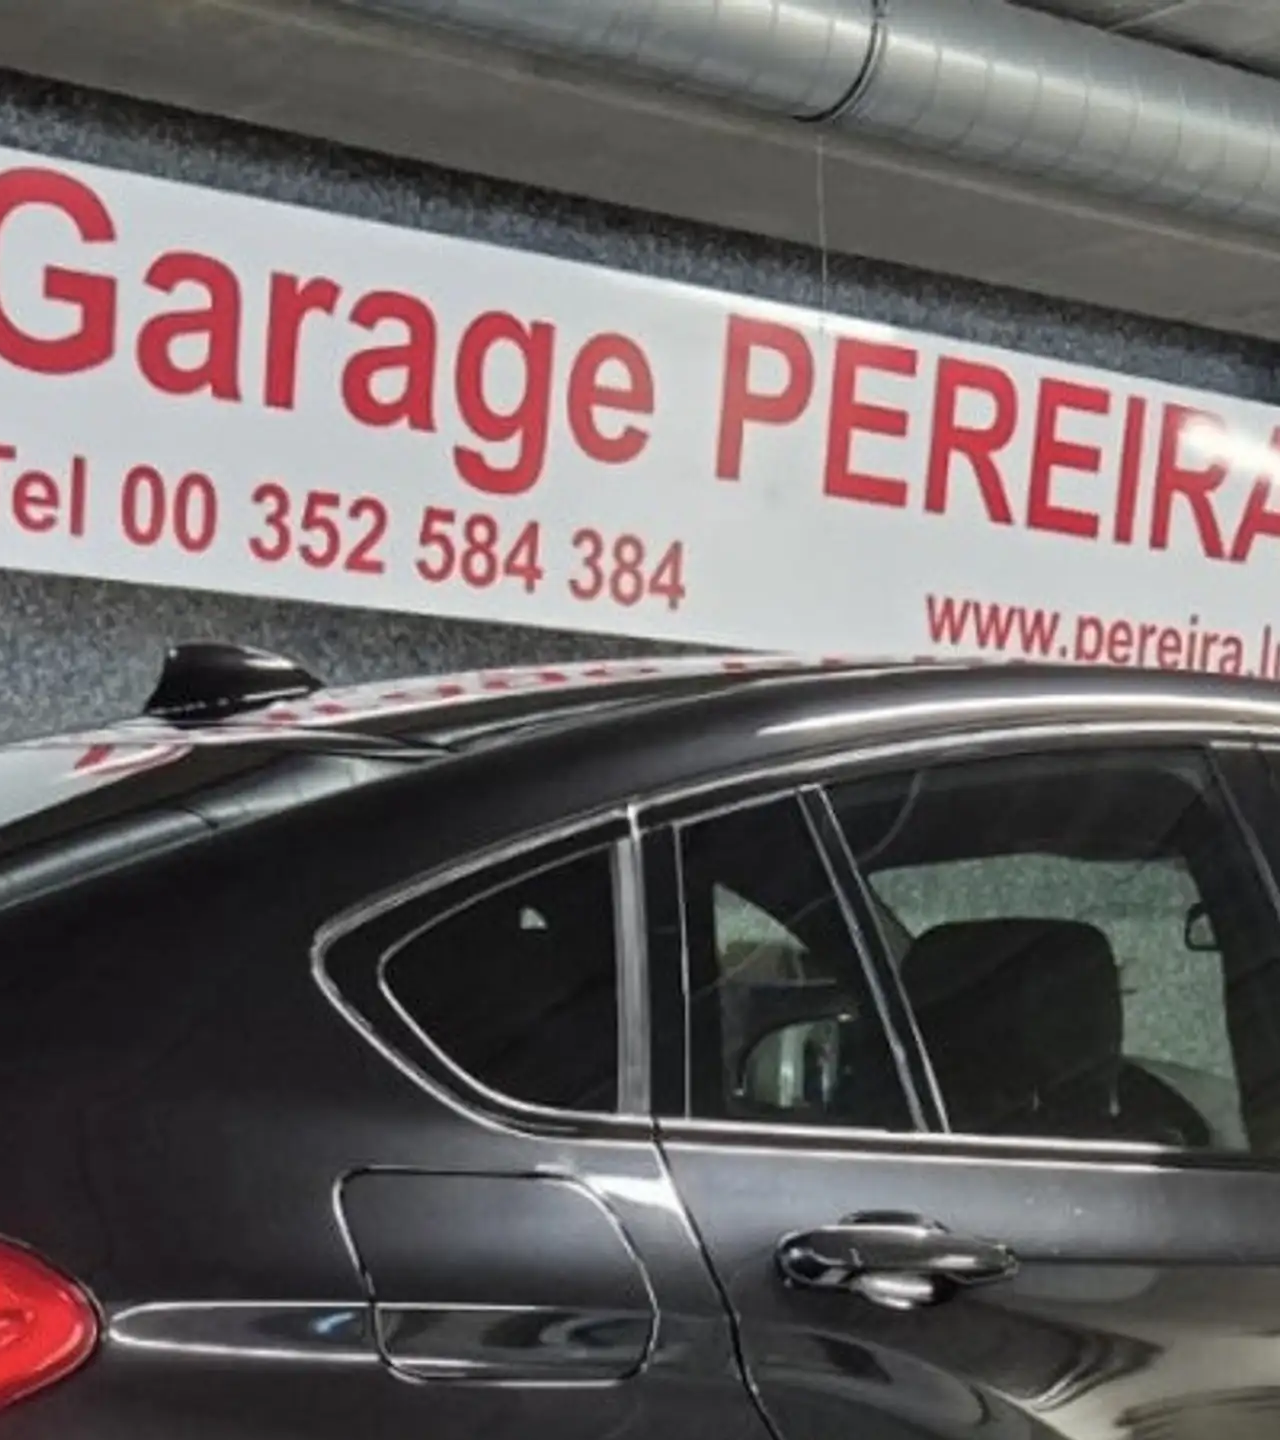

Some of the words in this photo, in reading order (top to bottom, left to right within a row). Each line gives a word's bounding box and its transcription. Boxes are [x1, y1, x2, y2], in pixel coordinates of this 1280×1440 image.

[120, 465, 218, 553] 00
[248, 482, 388, 576] 352
[415, 504, 543, 594] 584
[567, 527, 686, 612] 384
